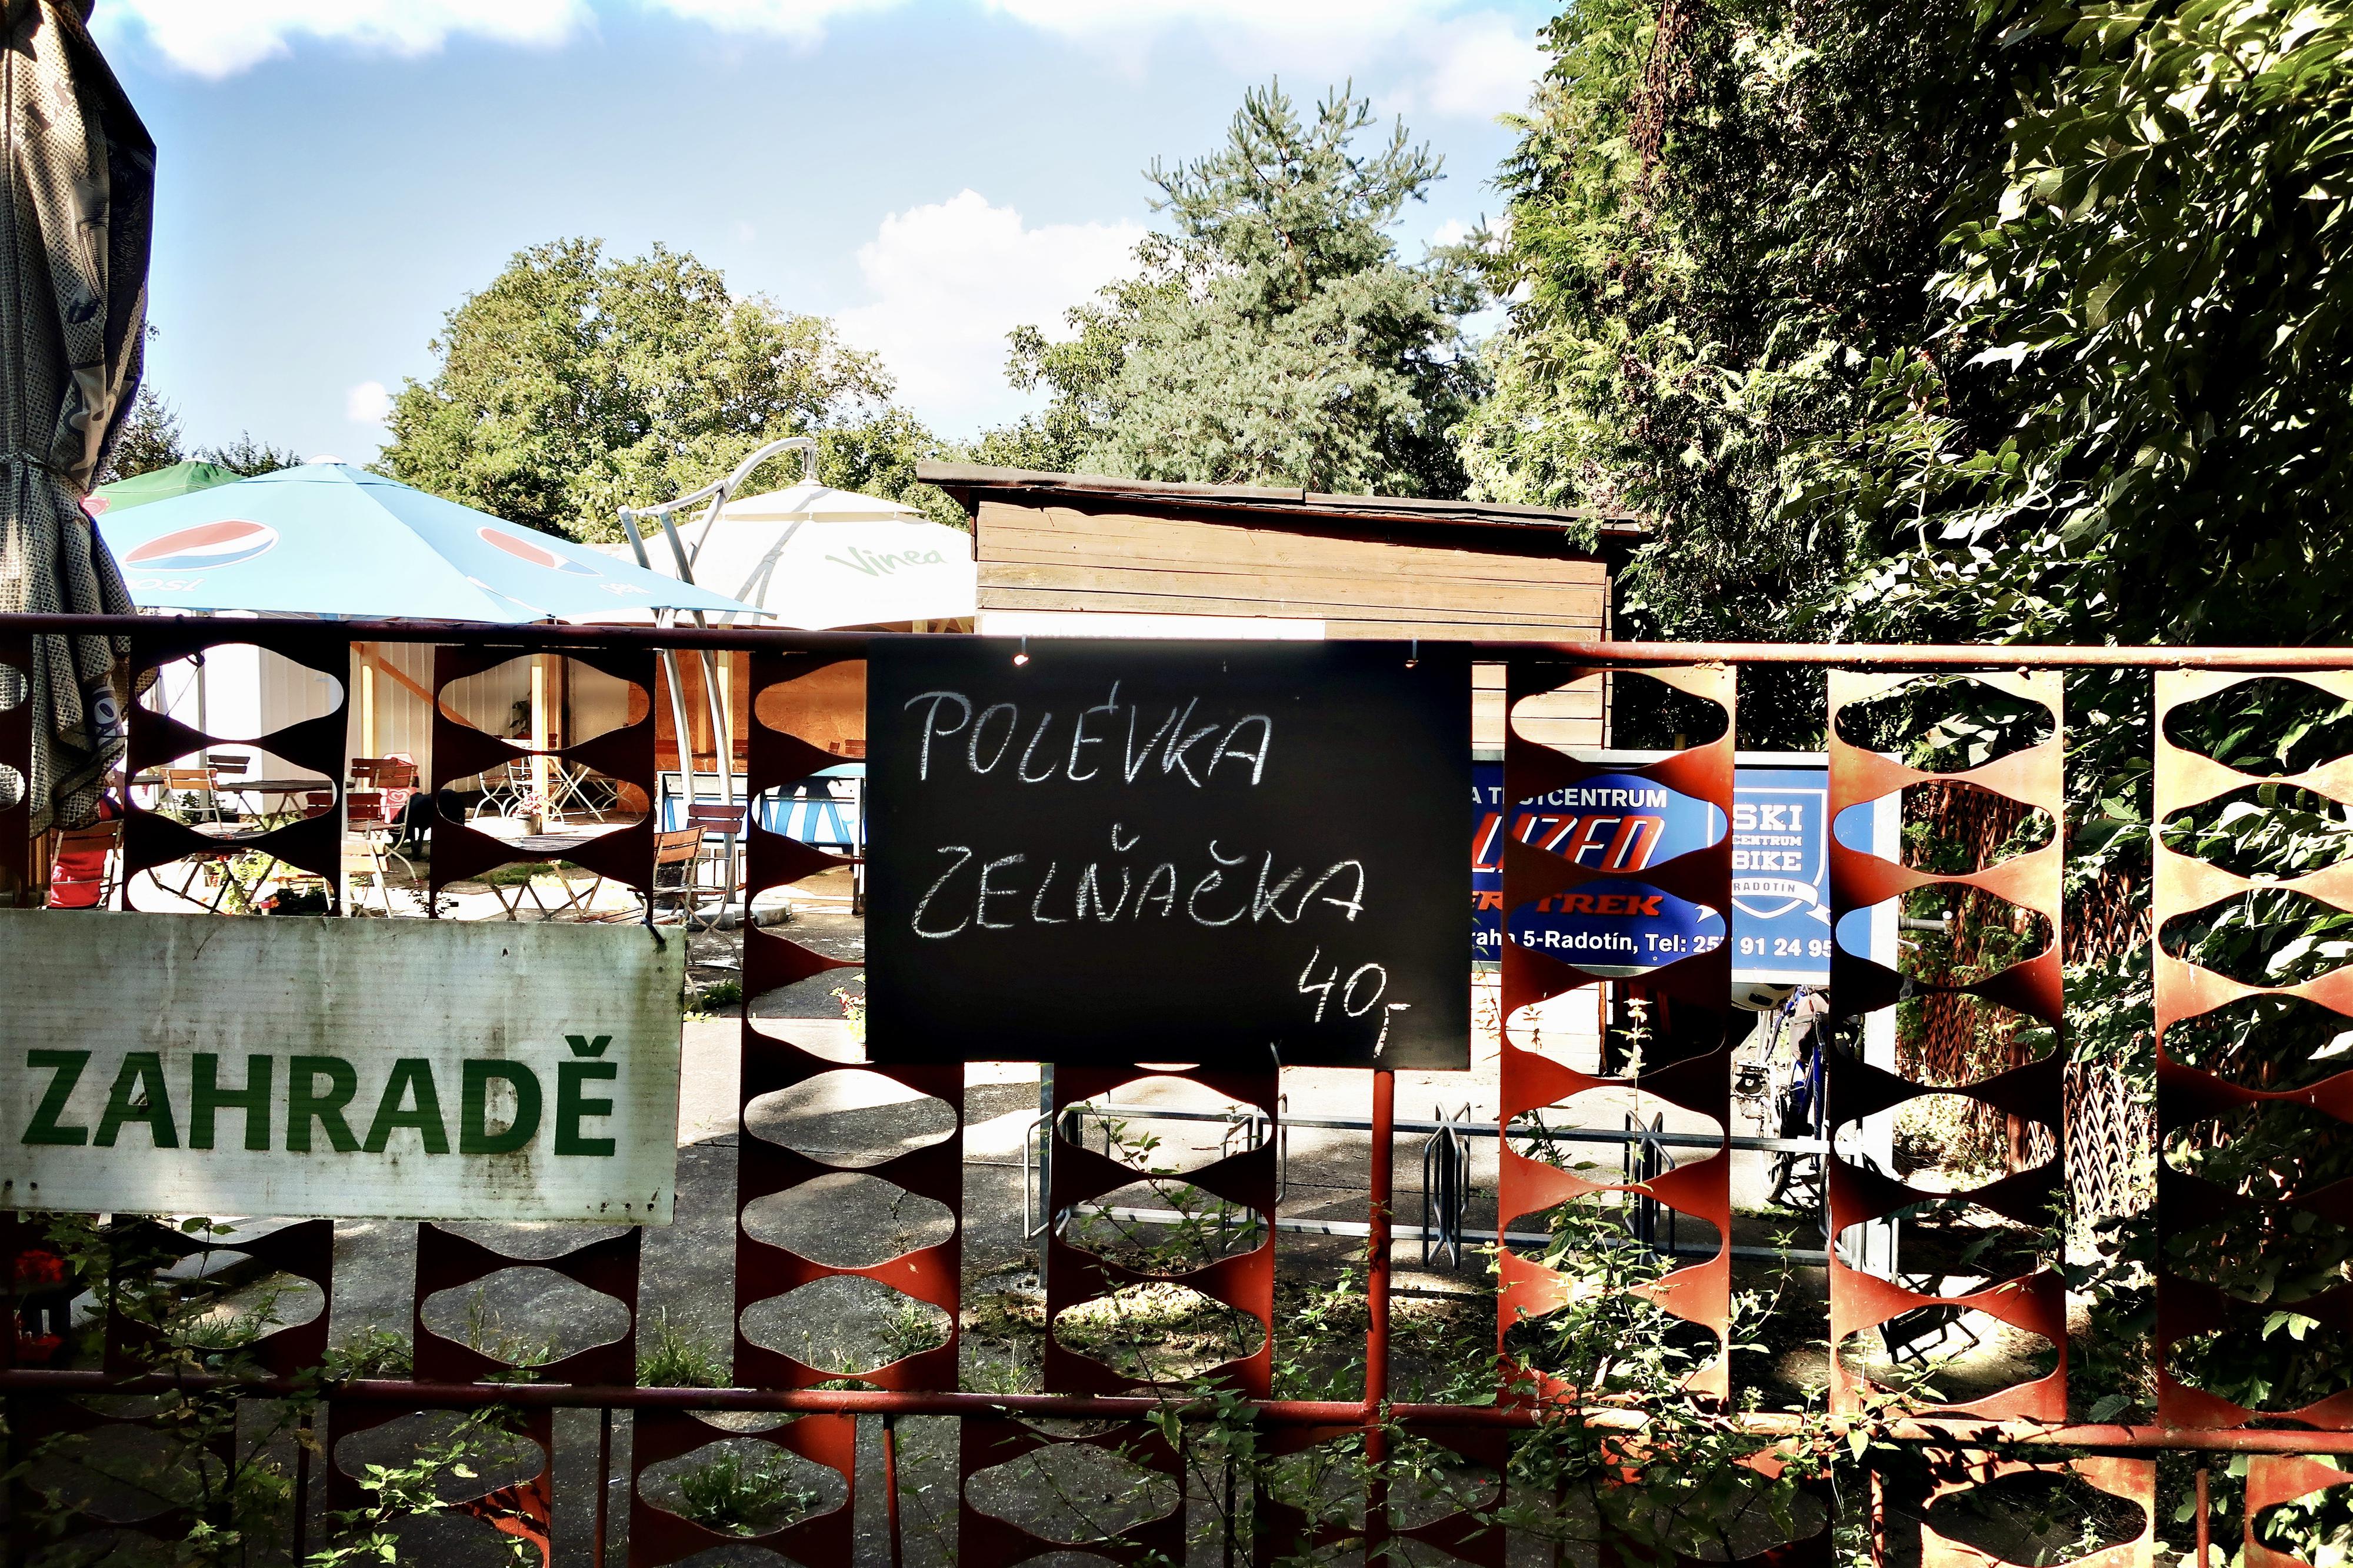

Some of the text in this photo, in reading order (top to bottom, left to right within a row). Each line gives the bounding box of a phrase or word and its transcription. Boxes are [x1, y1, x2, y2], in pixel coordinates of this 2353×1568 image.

[825, 546, 948, 577] Vinea
[904, 679, 1273, 788] POLÉVKA
[1732, 804, 1804, 832] SKI
[1732, 835, 1803, 846] CENTRUM
[1731, 850, 1802, 871] BIKE
[1732, 882, 1795, 893] RADOTÍN
[1535, 893, 1664, 916] TREK
[1522, 930, 1639, 955] 5-Radotín,
[1645, 933, 1687, 953] Tel:
[1739, 936, 1766, 956] 91
[1773, 938, 1803, 958] 24
[21, 1034, 618, 1157] ZAHRADĚ
